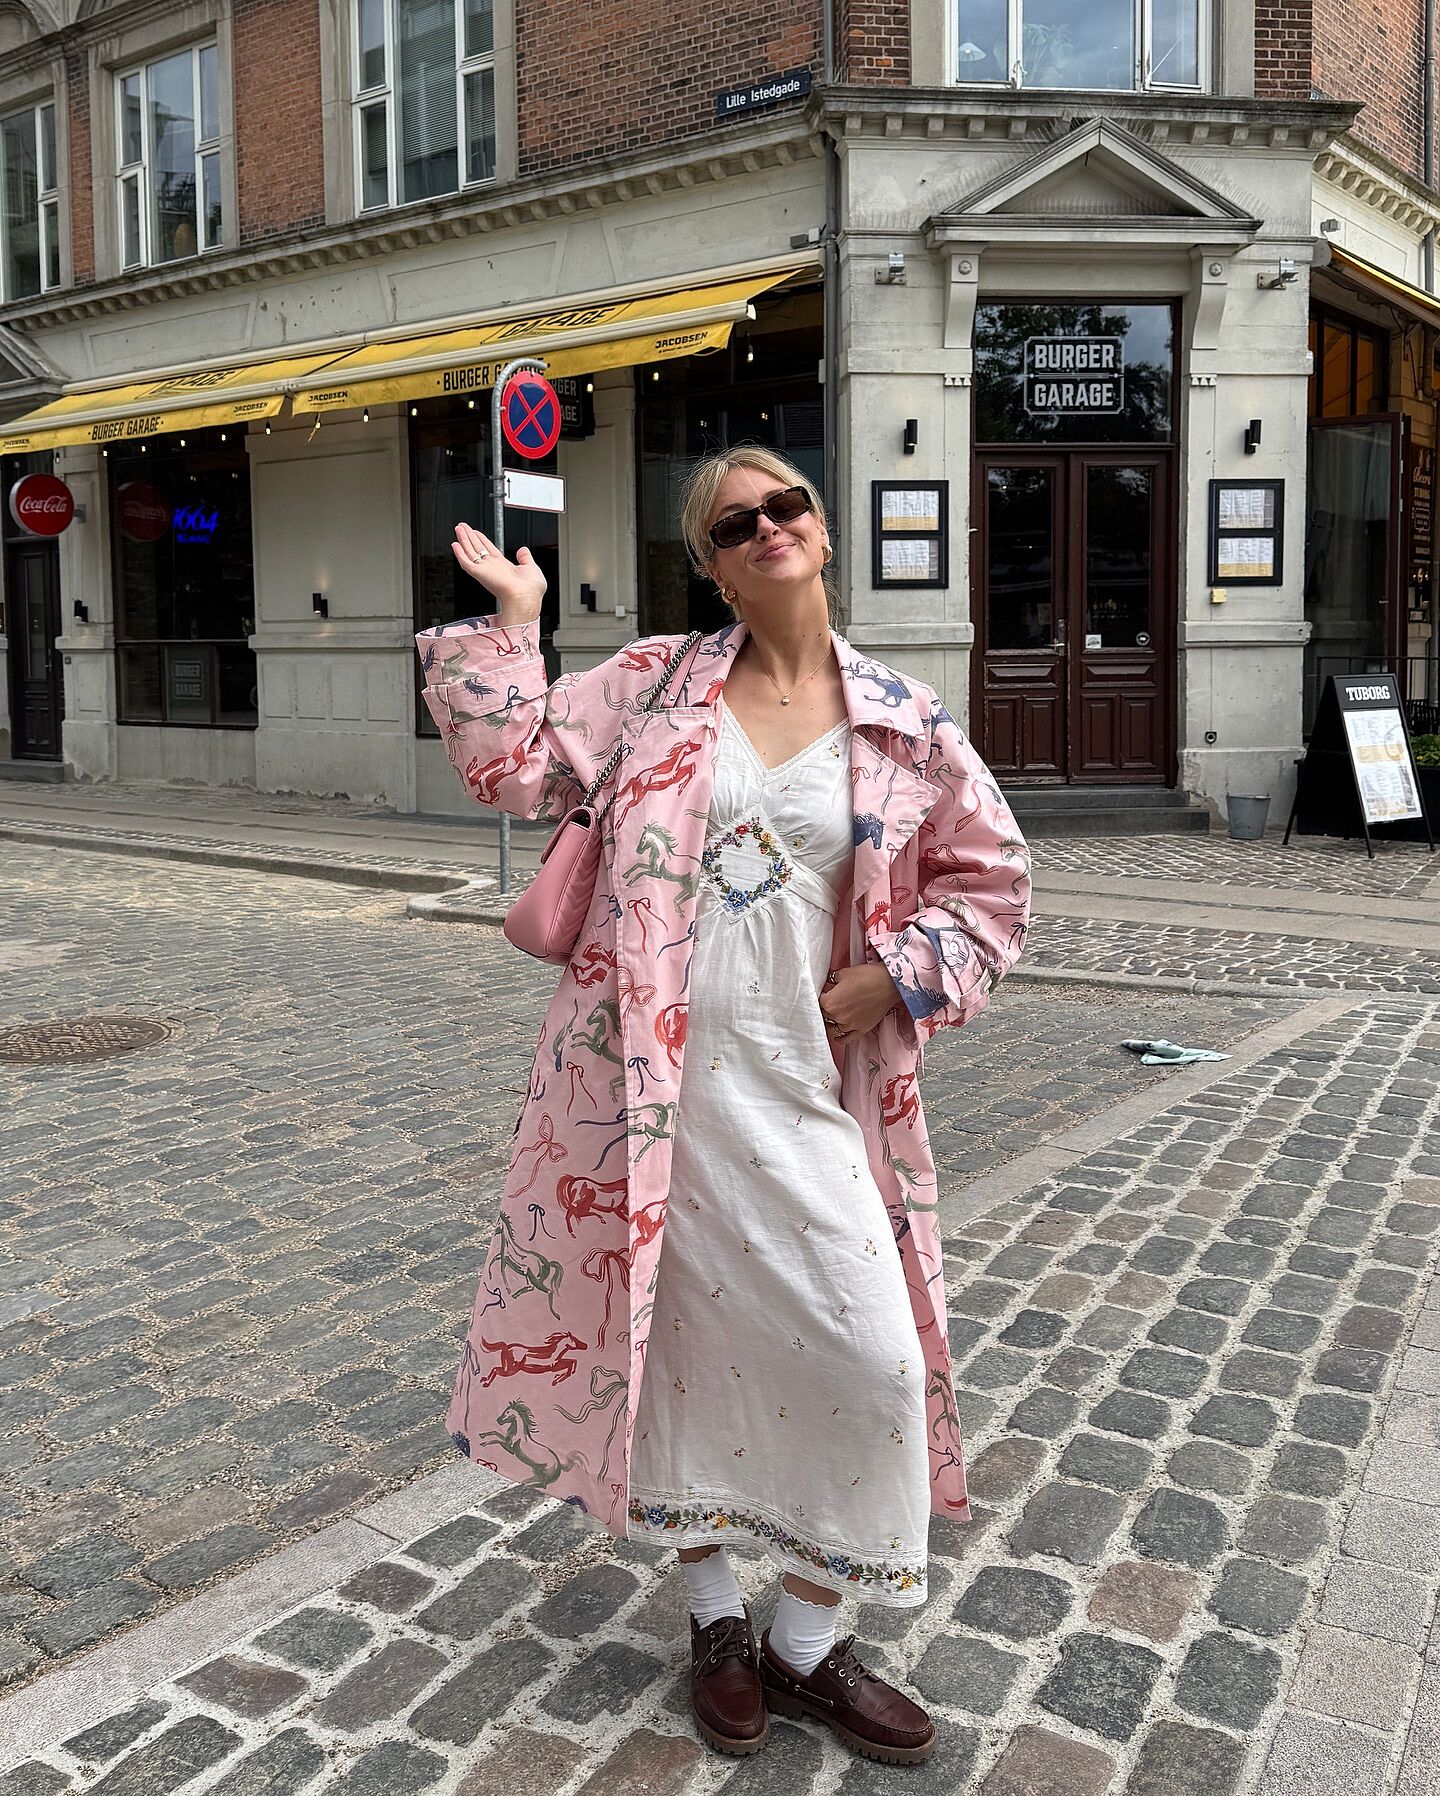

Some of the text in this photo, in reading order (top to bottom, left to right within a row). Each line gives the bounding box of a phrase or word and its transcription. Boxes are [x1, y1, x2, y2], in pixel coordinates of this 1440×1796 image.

[726, 79, 800, 108] Lille Istedgade
[655, 331, 708, 349] JACOBSEN
[1034, 344, 1114, 368] BURGER
[443, 365, 489, 392] BURGER
[308, 391, 348, 402] JACOBSEN
[1034, 383, 1114, 407] GARAGE
[233, 402, 269, 413] JACOBSEN
[91, 416, 161, 441] BURGER GARAGE
[19, 495, 67, 514] Coca-Cola
[172, 504, 220, 534] 1664
[1345, 685, 1391, 701] TUBORG
